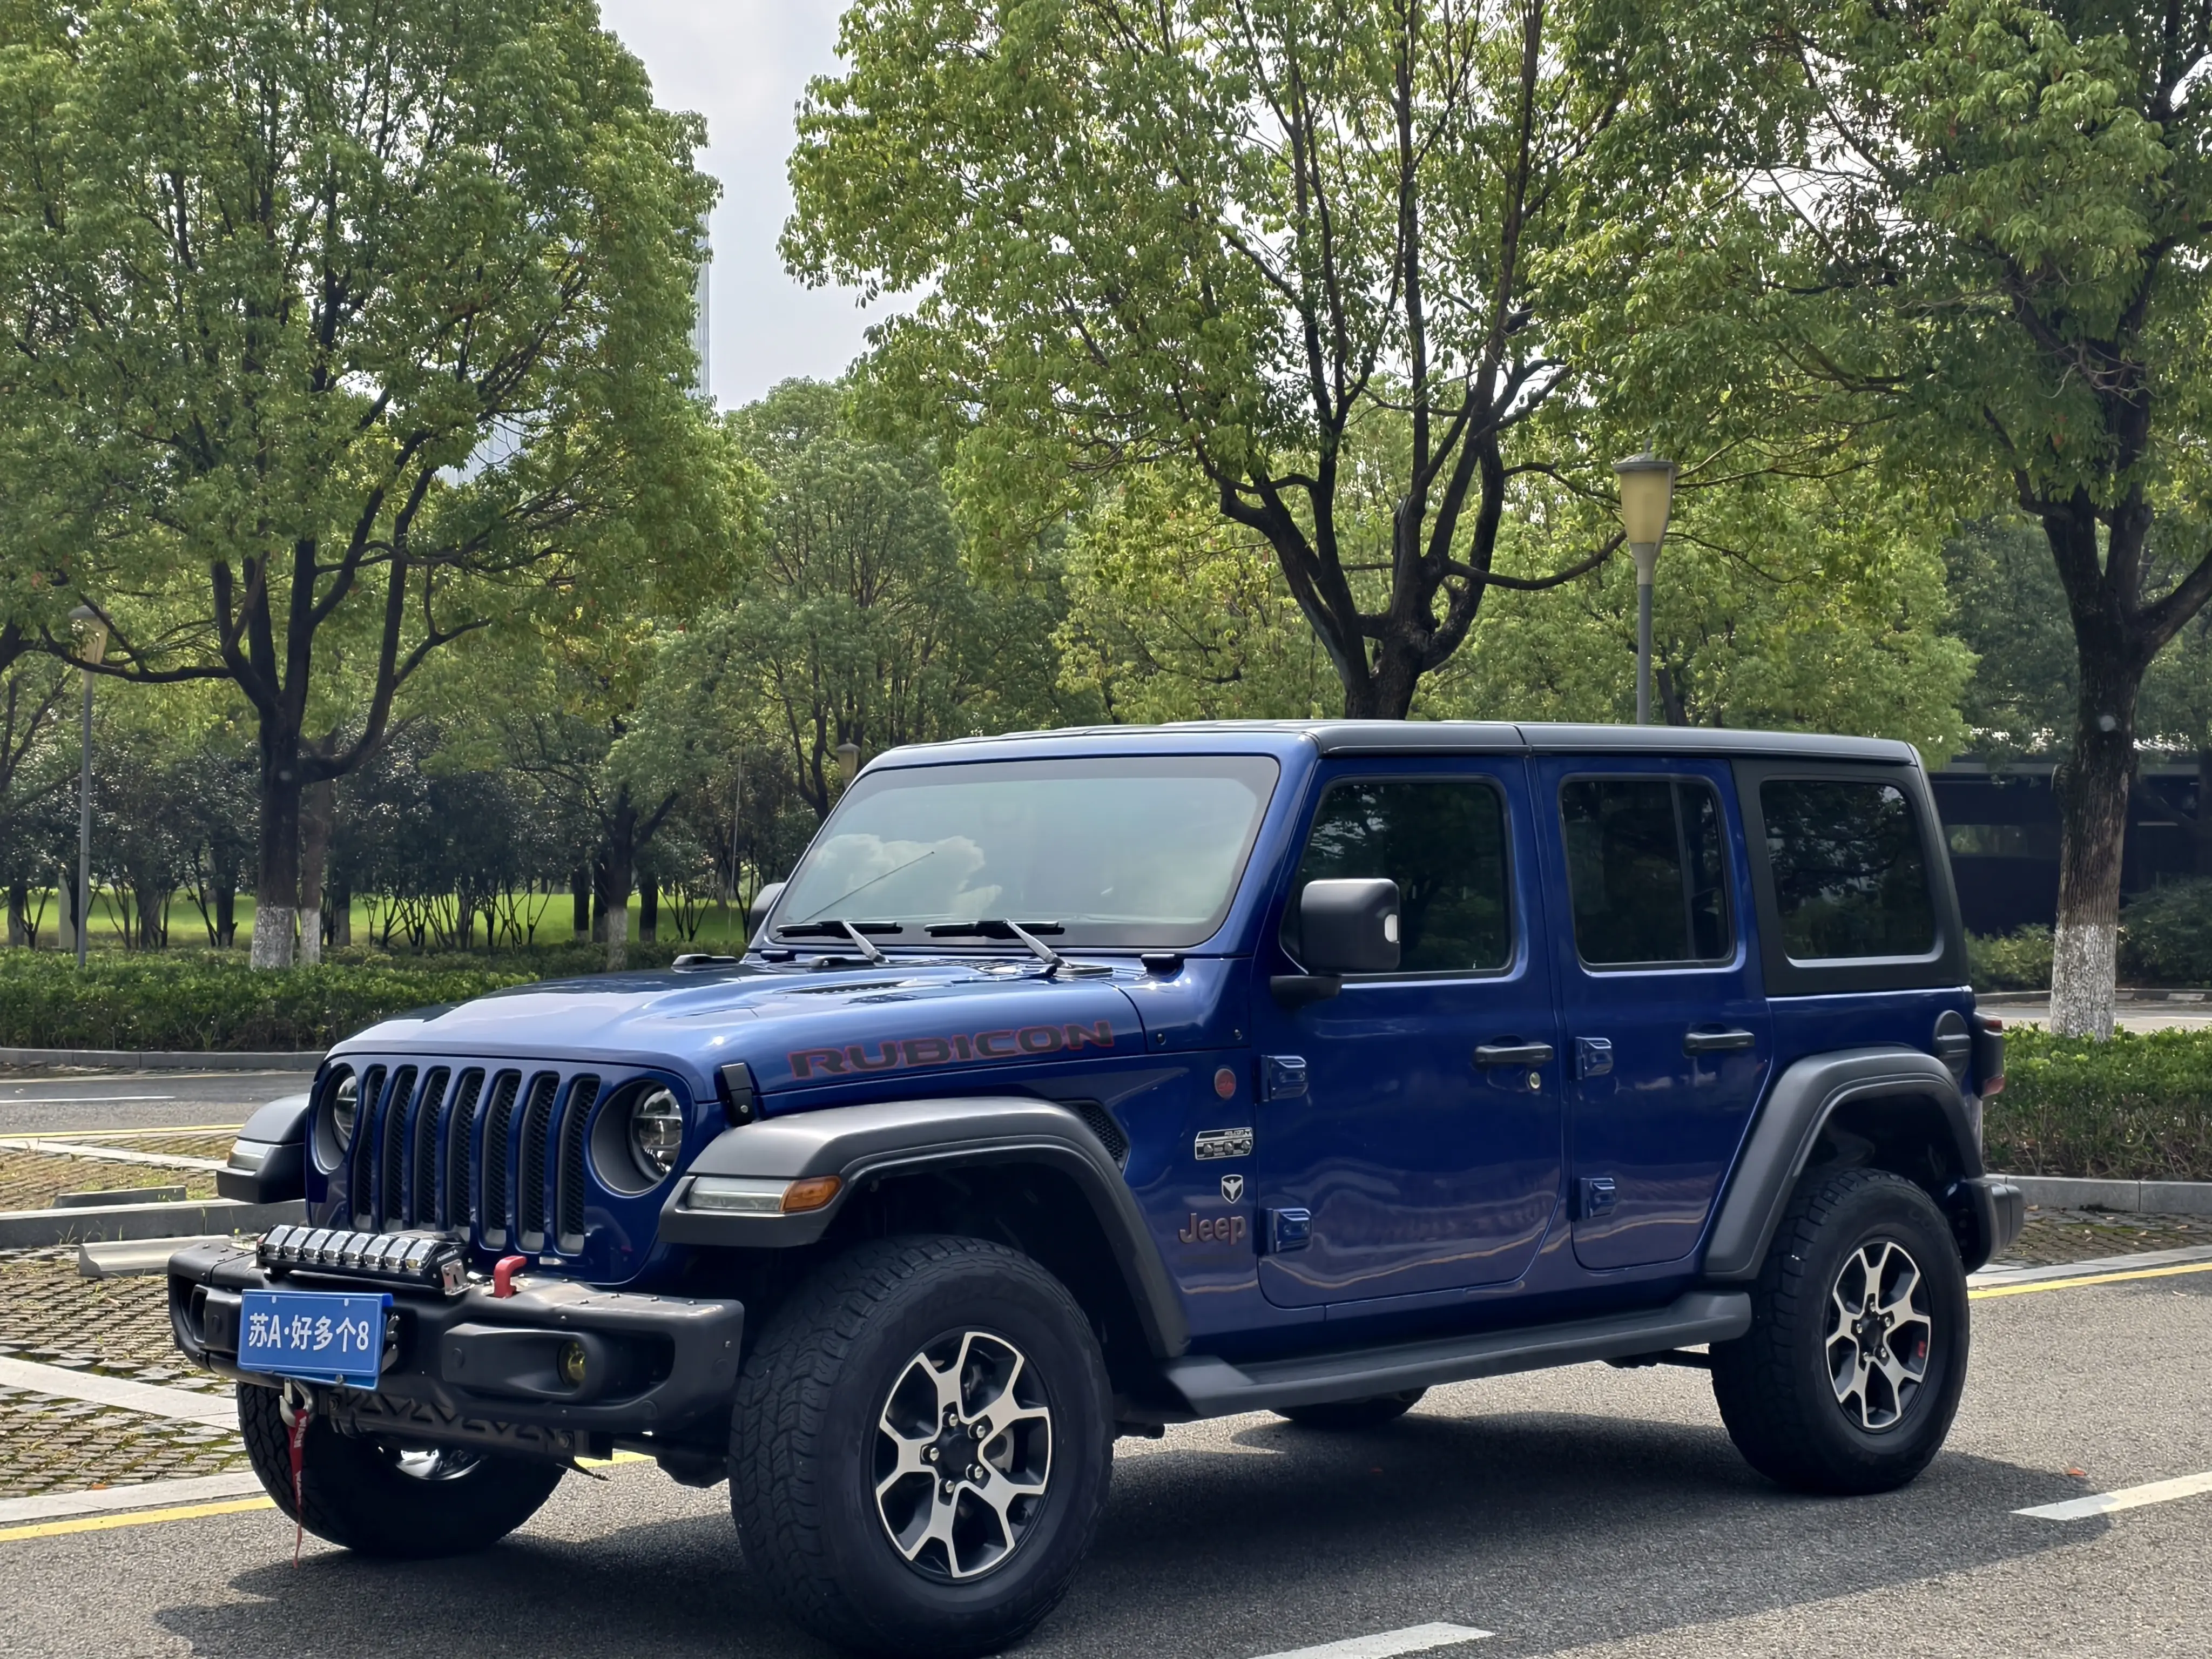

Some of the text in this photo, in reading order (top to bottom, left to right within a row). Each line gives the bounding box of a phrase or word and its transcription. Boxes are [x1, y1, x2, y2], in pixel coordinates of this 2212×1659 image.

[787, 1020, 1115, 1080] RUBICON
[1179, 1213, 1246, 1245] Jeep
[249, 1313, 369, 1352] 苏A·好多个8
